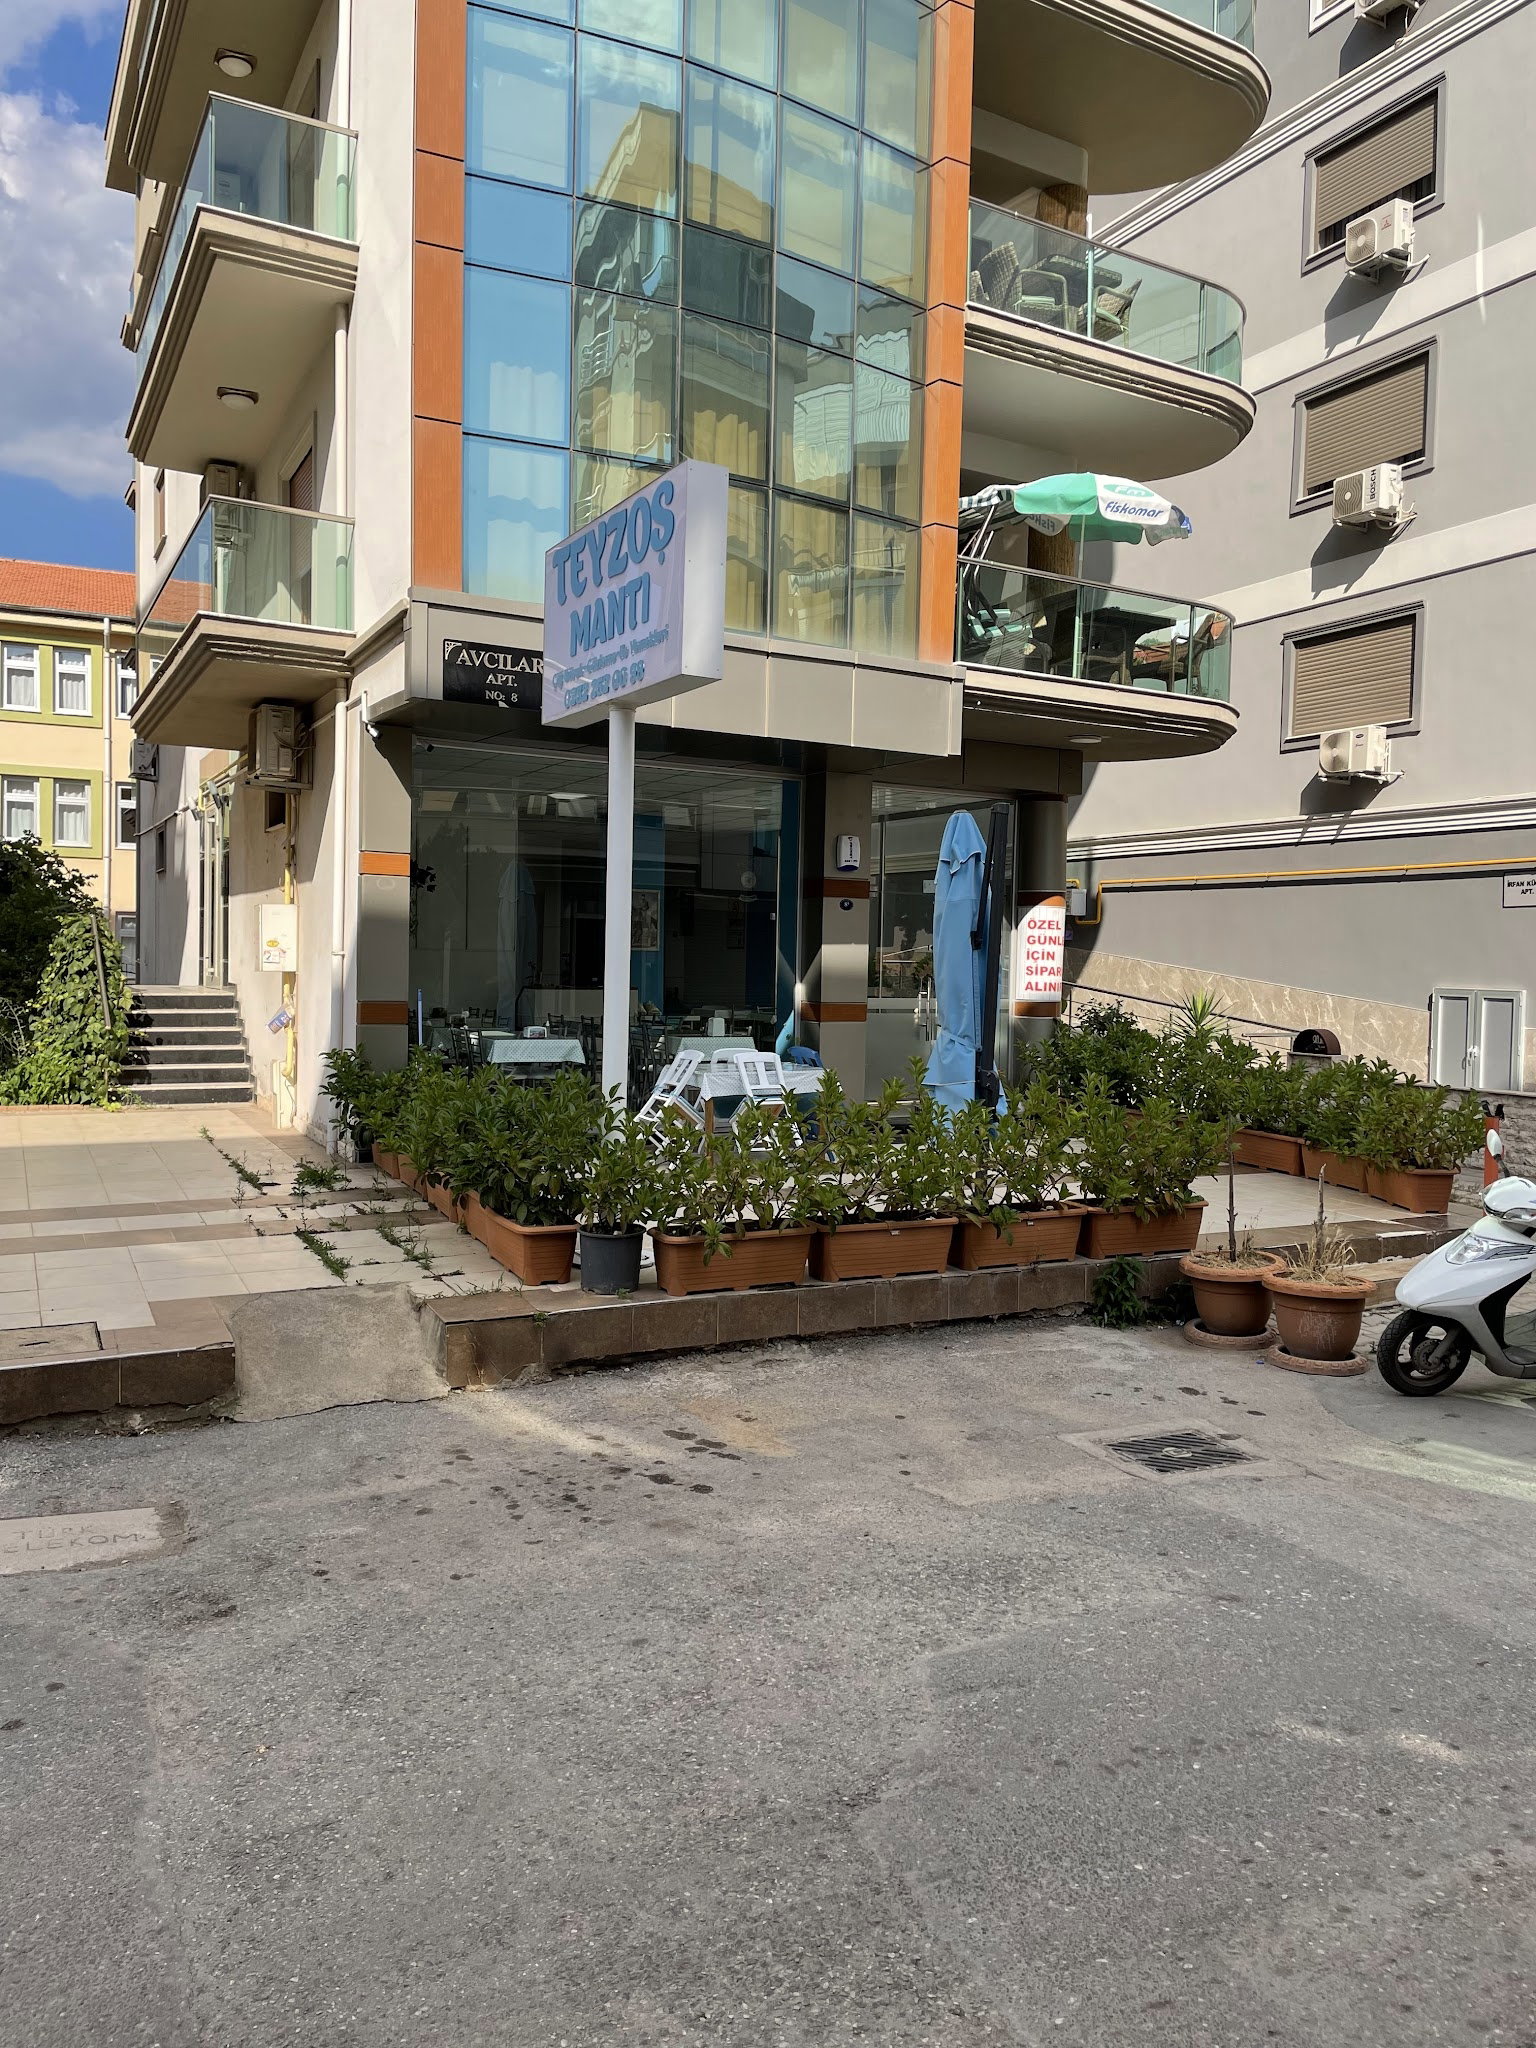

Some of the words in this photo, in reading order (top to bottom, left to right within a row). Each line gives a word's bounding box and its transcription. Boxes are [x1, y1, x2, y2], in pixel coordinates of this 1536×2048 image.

[1105, 501, 1164, 518] Fiskomar
[552, 480, 675, 606] TEYZOŞ
[570, 572, 650, 657] MANTI
[456, 648, 544, 674] AVCILAR
[486, 673, 518, 687] APT.
[485, 690, 506, 701] NO:
[511, 692, 518, 702] 8
[1027, 918, 1061, 930] ÖZEL
[1026, 948, 1055, 963] İÇİN
